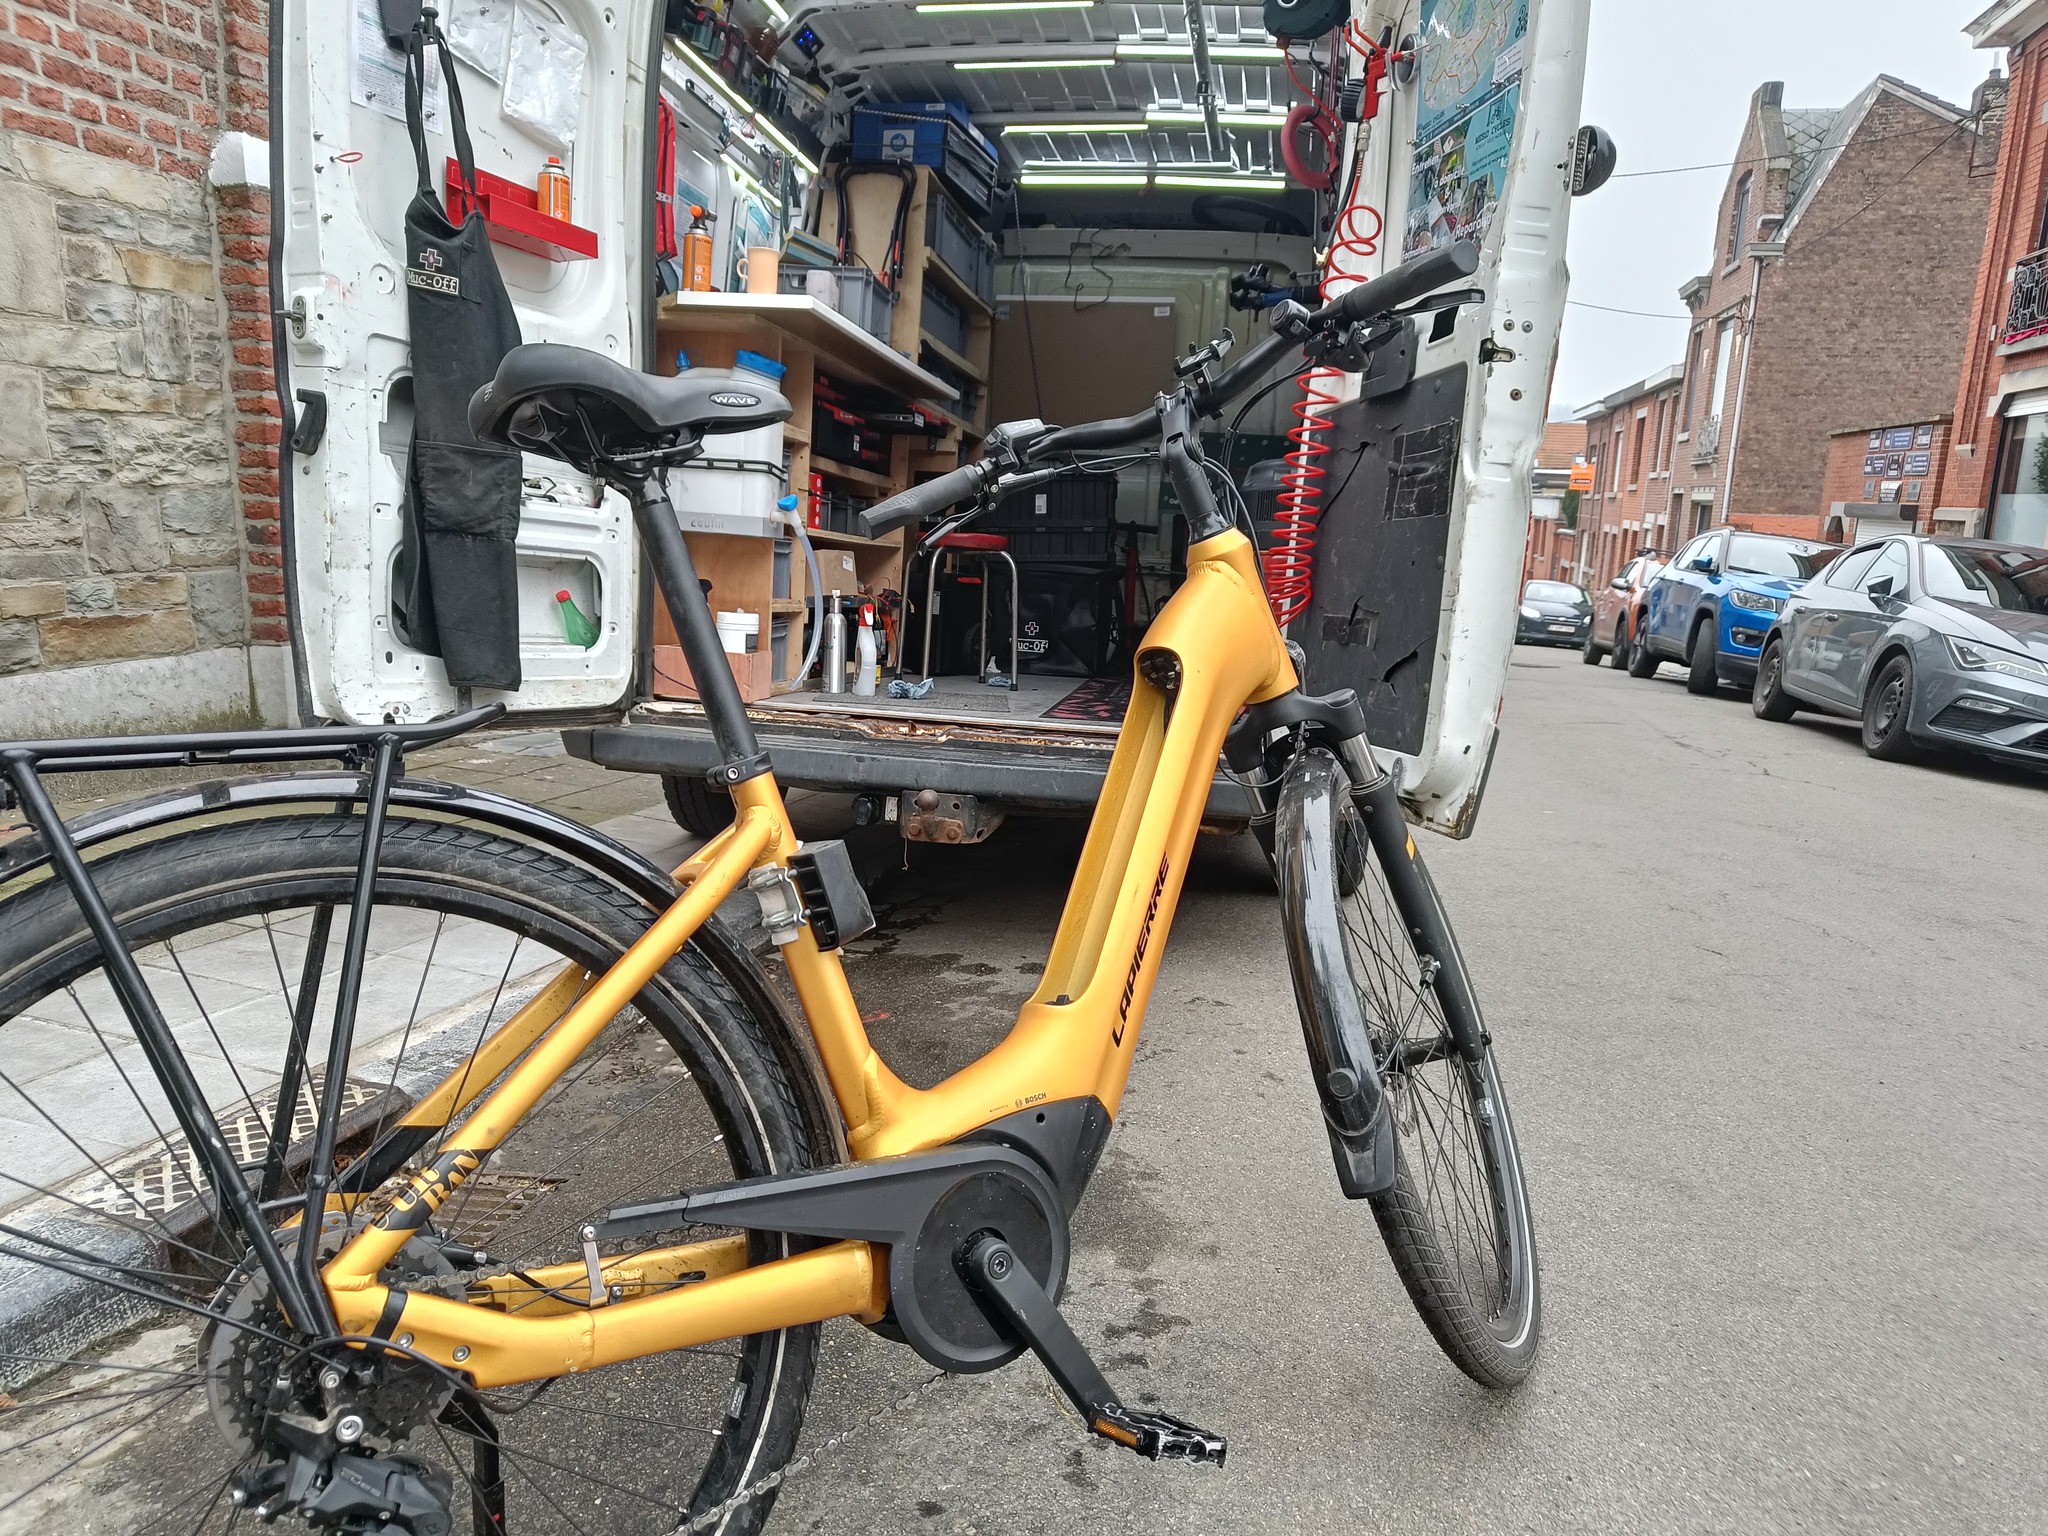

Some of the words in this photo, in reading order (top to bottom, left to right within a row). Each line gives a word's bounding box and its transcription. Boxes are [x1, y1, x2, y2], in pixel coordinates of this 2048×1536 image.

[1412, 154, 1440, 175] Entretien
[1439, 166, 1467, 187] domicile
[714, 395, 758, 405] WAVE
[1112, 851, 1169, 1048] LAPIERRE
[1025, 1092, 1047, 1104] BOSCH
